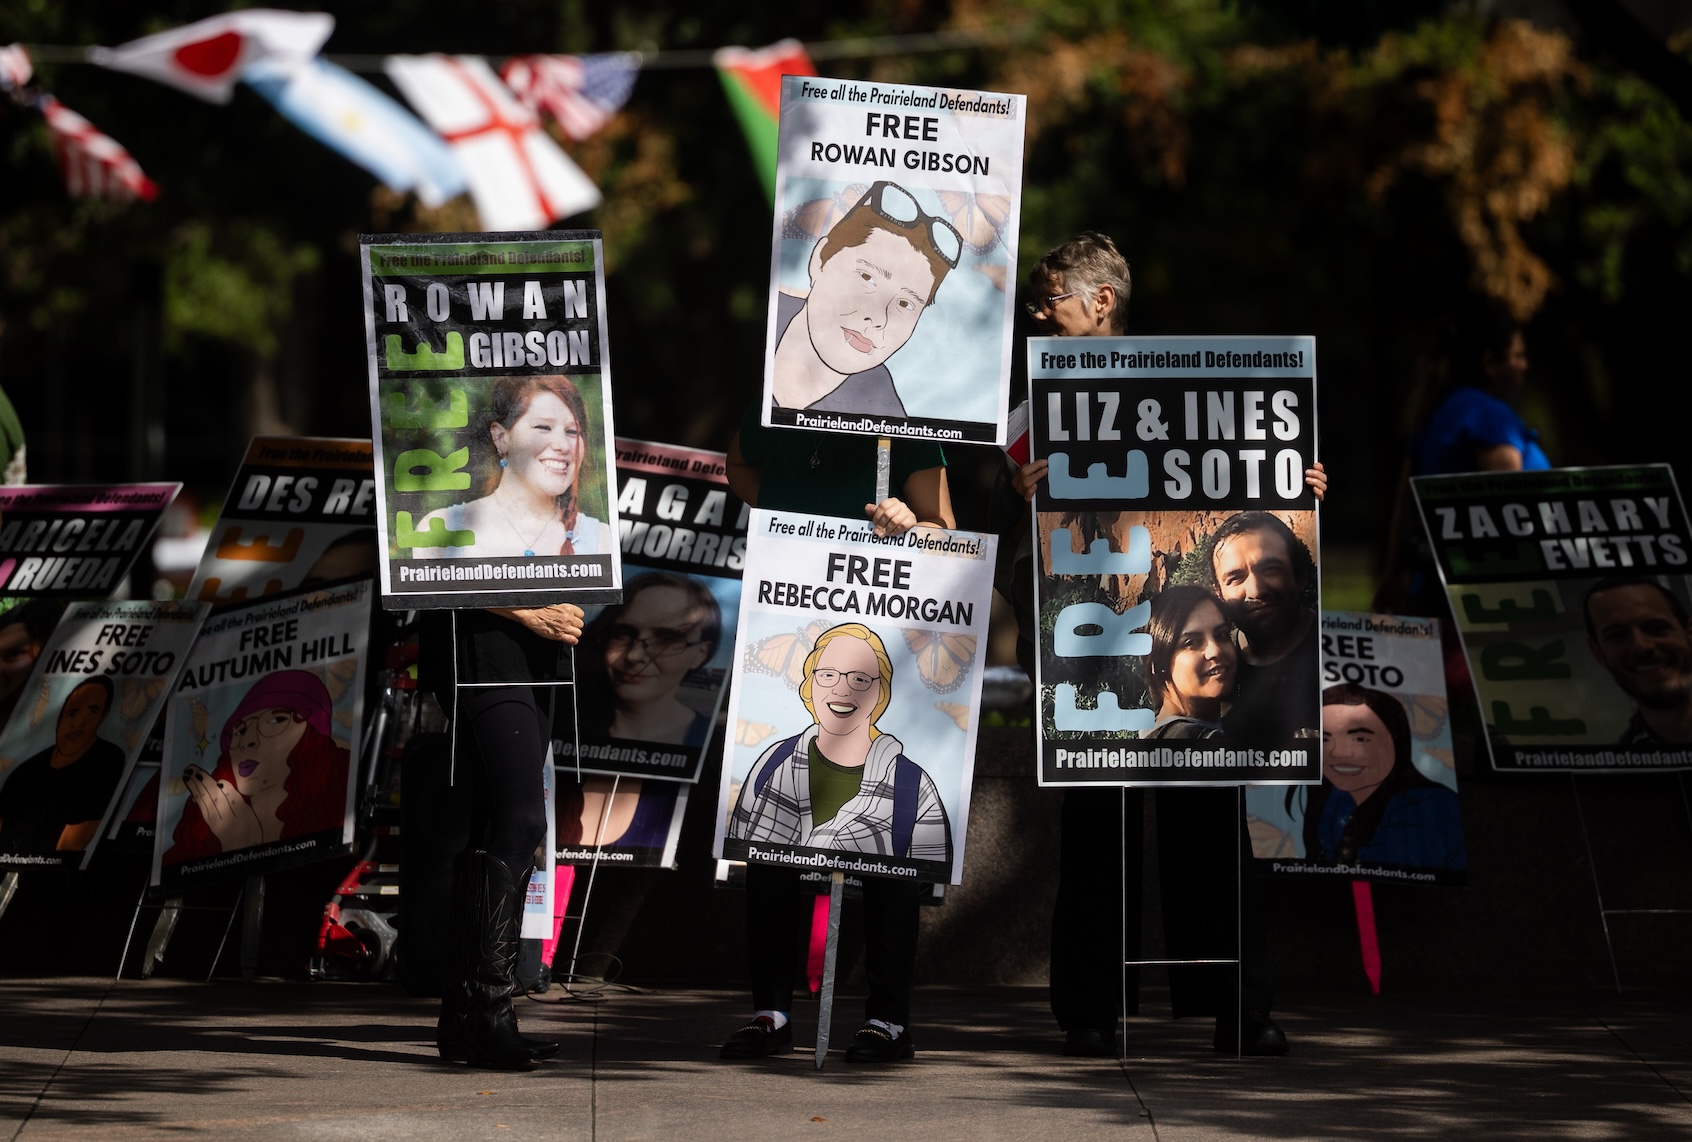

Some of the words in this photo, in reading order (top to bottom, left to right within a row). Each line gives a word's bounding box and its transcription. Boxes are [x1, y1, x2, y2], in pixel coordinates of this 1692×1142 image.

[801, 81, 827, 99] Free
[830, 84, 845, 100] all
[848, 86, 867, 102] the
[869, 88, 937, 109] Prairieland
[939, 94, 1010, 115] Defendants!
[866, 112, 939, 141] FREE
[811, 142, 896, 168] ROWAN
[903, 150, 989, 175] GIBSON
[380, 253, 407, 267] Free
[410, 253, 431, 266] the
[434, 251, 505, 266] Prairieland
[508, 249, 585, 264] Defendants!
[384, 280, 588, 322] ROWAN
[469, 330, 590, 369] GIBSON
[1041, 352, 1076, 369] Free
[1080, 352, 1107, 369] the
[1110, 351, 1200, 369] Prairieland
[1205, 351, 1304, 368] Defendants!
[796, 414, 963, 439] PrairielandDefendants.com
[1047, 391, 1121, 441] LIZ
[1136, 398, 1169, 441] &
[1184, 389, 1300, 441] INES
[259, 446, 287, 459] Free
[289, 447, 311, 460] the
[312, 448, 374, 462] Prairiela
[386, 332, 475, 548] FREE
[616, 450, 690, 470] rairieland
[1163, 449, 1303, 500] SOTO
[236, 474, 319, 513] DES
[322, 478, 377, 516] RE
[1435, 496, 1671, 540] ZACHARY
[0, 518, 146, 553] ARICELA
[619, 519, 747, 571] MORRIS
[769, 517, 795, 535] Free
[798, 521, 814, 537] all
[816, 522, 835, 540] the
[838, 525, 905, 547] Prairieand
[908, 532, 981, 556] Defendants!
[1539, 533, 1689, 571] EVETTS
[7, 556, 122, 591] RUEDA
[400, 563, 602, 582] PrairielandDefendants.com
[826, 553, 912, 590] FREE
[758, 580, 861, 614] REBECCA
[865, 592, 973, 626] MORGAN
[1047, 449, 1155, 731] FREE
[213, 618, 227, 632] all
[228, 616, 243, 628] the
[245, 602, 299, 625] Prairieland
[300, 588, 358, 612] Defendants!
[1322, 617, 1362, 630] rieland
[95, 625, 153, 647] FREE
[239, 619, 298, 651] FREE
[1322, 634, 1374, 660] REE
[1446, 540, 1587, 735] FREE
[45, 650, 103, 674] INES
[104, 652, 175, 675] SOTO
[178, 646, 292, 692] AUTUMN
[301, 633, 355, 663] HILL
[1325, 661, 1404, 688] SOTO
[1056, 748, 1308, 768] PrairielandDefendants.com
[1514, 751, 1692, 766] PrairielandDefendants
[181, 839, 316, 876] PrairielandDefendants.com
[749, 847, 917, 877] PrairielandDefendants.com
[1272, 863, 1436, 881] PrairielandDefendants.com
